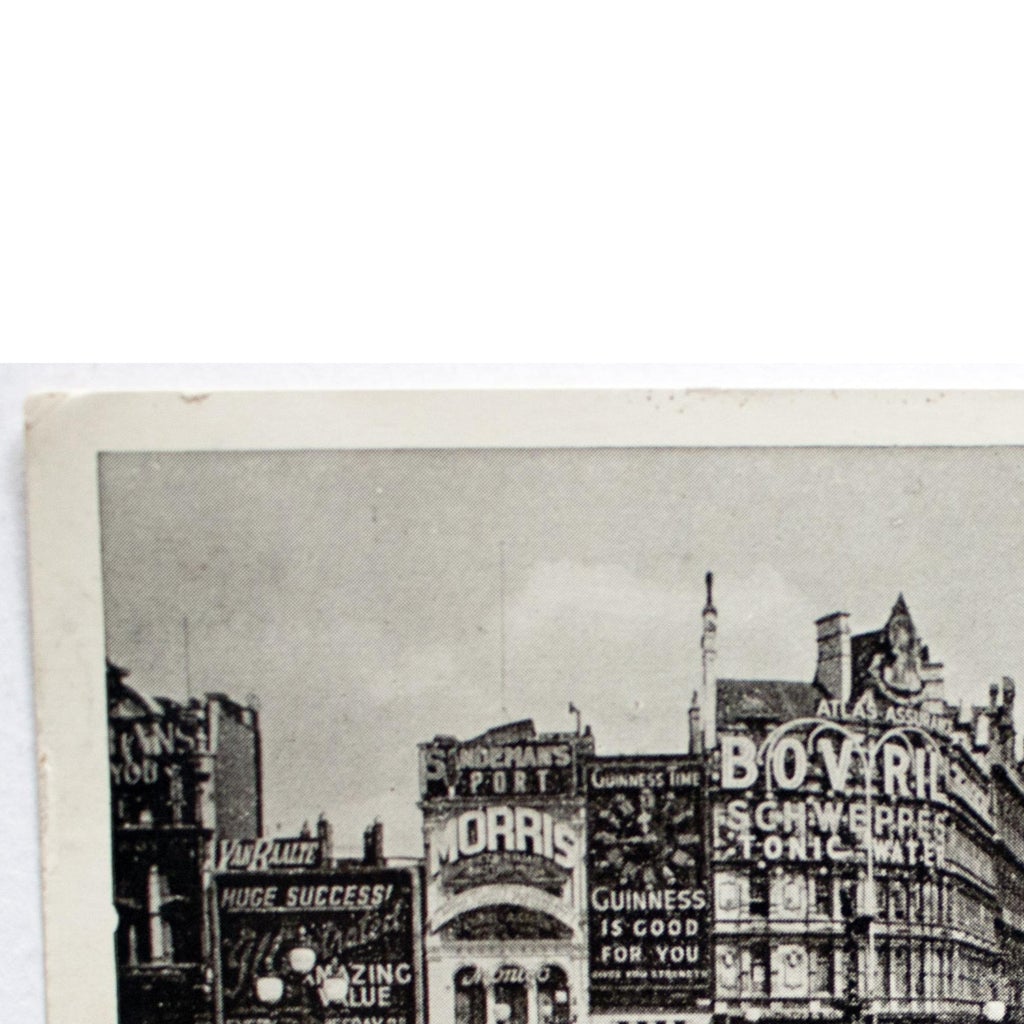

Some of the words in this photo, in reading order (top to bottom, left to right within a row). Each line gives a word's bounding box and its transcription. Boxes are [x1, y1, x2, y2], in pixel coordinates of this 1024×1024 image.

[816, 689, 878, 721] ATLAS
[591, 766, 664, 788] GUINNESS
[669, 766, 699, 787] TIME
[720, 736, 950, 801] BOVRIL
[470, 770, 550, 793] PORT
[727, 800, 949, 839] SCHWEPPES
[430, 806, 575, 877] MORRIS
[737, 835, 846, 861] TONIC
[222, 886, 278, 908] HUGE
[286, 884, 394, 907] SUCCESS!
[591, 888, 706, 911] GUINNESS
[602, 919, 623, 937] IS
[632, 918, 700, 938] GOOD
[600, 946, 643, 965] FOR
[655, 945, 701, 964] YOU
